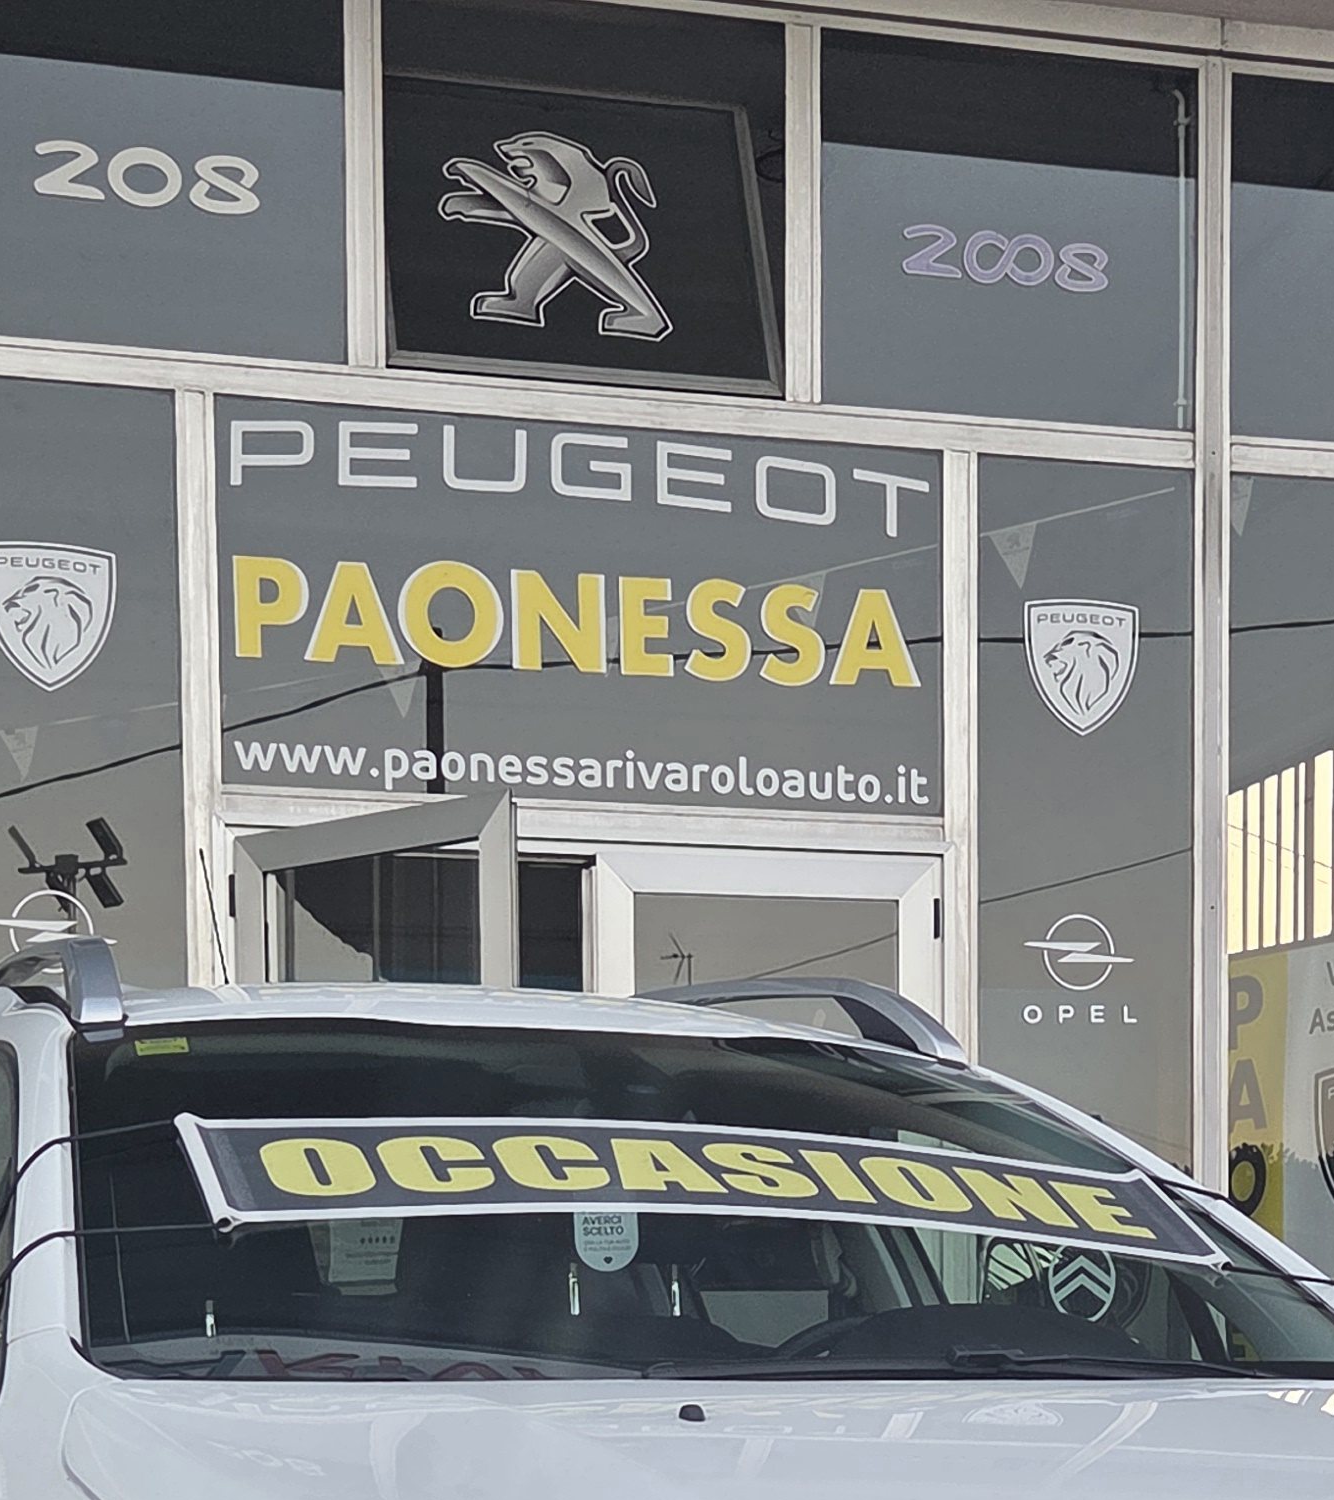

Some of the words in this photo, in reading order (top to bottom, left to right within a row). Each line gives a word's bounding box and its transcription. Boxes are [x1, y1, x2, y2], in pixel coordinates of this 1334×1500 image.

[33, 139, 260, 214] 208
[902, 224, 1109, 292] 2008
[230, 420, 930, 537] PEUGEOT
[231, 555, 922, 688] PAONESSA
[1036, 612, 1127, 628] PEUGEOT
[233, 739, 929, 805] www.paonessarivaroloauto.it
[1022, 1003, 1138, 1024] OPEL
[260, 1135, 1157, 1240] OCCASIONE
[582, 1225, 625, 1237] SCELTO
